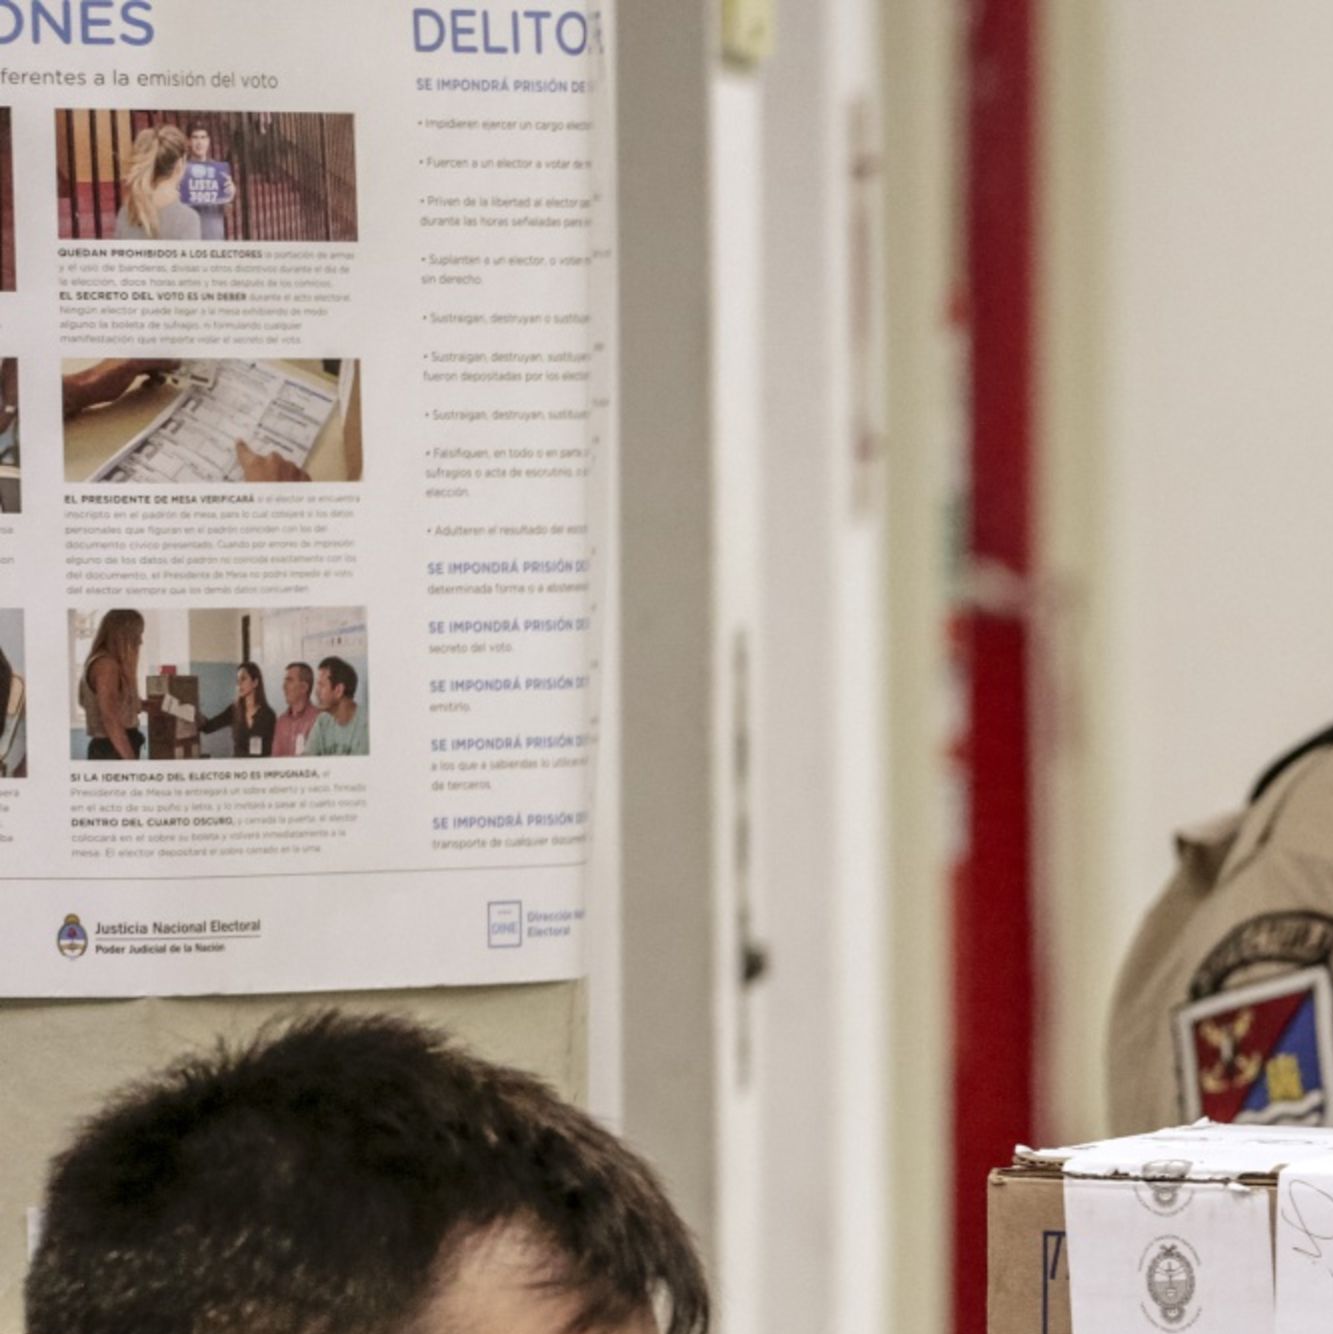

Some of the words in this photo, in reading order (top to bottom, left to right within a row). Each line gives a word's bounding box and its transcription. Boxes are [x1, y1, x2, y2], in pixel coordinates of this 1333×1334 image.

[0, 68, 87, 87] ferentes
[94, 74, 105, 87] a
[113, 70, 129, 87] la
[137, 71, 206, 88] emisión
[211, 72, 236, 88] del
[242, 74, 278, 89] voto
[416, 77, 432, 91] SE
[437, 76, 509, 92] IMPONDRÁ
[514, 77, 567, 93] PRISIÓN
[58, 248, 107, 258] QUEDAN
[111, 248, 177, 258] PROHIBIDOS
[181, 250, 187, 258] A
[190, 250, 207, 258] LOS
[210, 250, 262, 258] ELECTORES
[59, 292, 72, 300] EL
[76, 292, 129, 300] SECRETO
[132, 292, 154, 300] DEL
[158, 292, 184, 300] VOTO
[217, 292, 246, 301] DEBER
[64, 495, 78, 504] EL
[81, 495, 150, 504] PRESIDENTE
[154, 495, 168, 504] DE
[171, 495, 197, 504] MESA
[200, 494, 254, 503] VERIFICARÁ
[427, 562, 443, 575] SE
[448, 559, 519, 574] IMPONDRÁ
[523, 558, 572, 573] PRISIÓN
[428, 621, 443, 634] SE
[449, 618, 520, 634] IMPONDRÁ
[524, 618, 572, 632] PRISIÓN
[430, 680, 446, 693] SE
[450, 677, 520, 692] IMPONDRÁ
[525, 676, 573, 690] PRISIÓN
[431, 739, 447, 752] SE
[452, 736, 522, 751] IMPONDRÁ
[526, 735, 574, 749] PRISIÓN
[70, 773, 80, 782] SI
[84, 773, 98, 782] LA
[102, 772, 164, 782] IDENTIDAD
[168, 772, 185, 781] DEL
[189, 772, 231, 780] ELECTOR
[234, 771, 248, 780] NO
[250, 771, 261, 779] ES
[71, 818, 118, 826] DENTRO
[122, 818, 143, 826] DEL
[147, 818, 190, 826] CUARTO
[432, 817, 448, 830] SE
[453, 814, 522, 829] IMPONDRÁ
[527, 814, 574, 827] PRISIÓN
[96, 922, 148, 935] Justicia
[153, 920, 206, 934] Nacional
[210, 919, 260, 932] Electoral
[96, 945, 125, 954] Poder
[129, 944, 166, 954] Judicial
[170, 944, 180, 953] de
[184, 944, 192, 952] la
[196, 942, 224, 952] Nación
